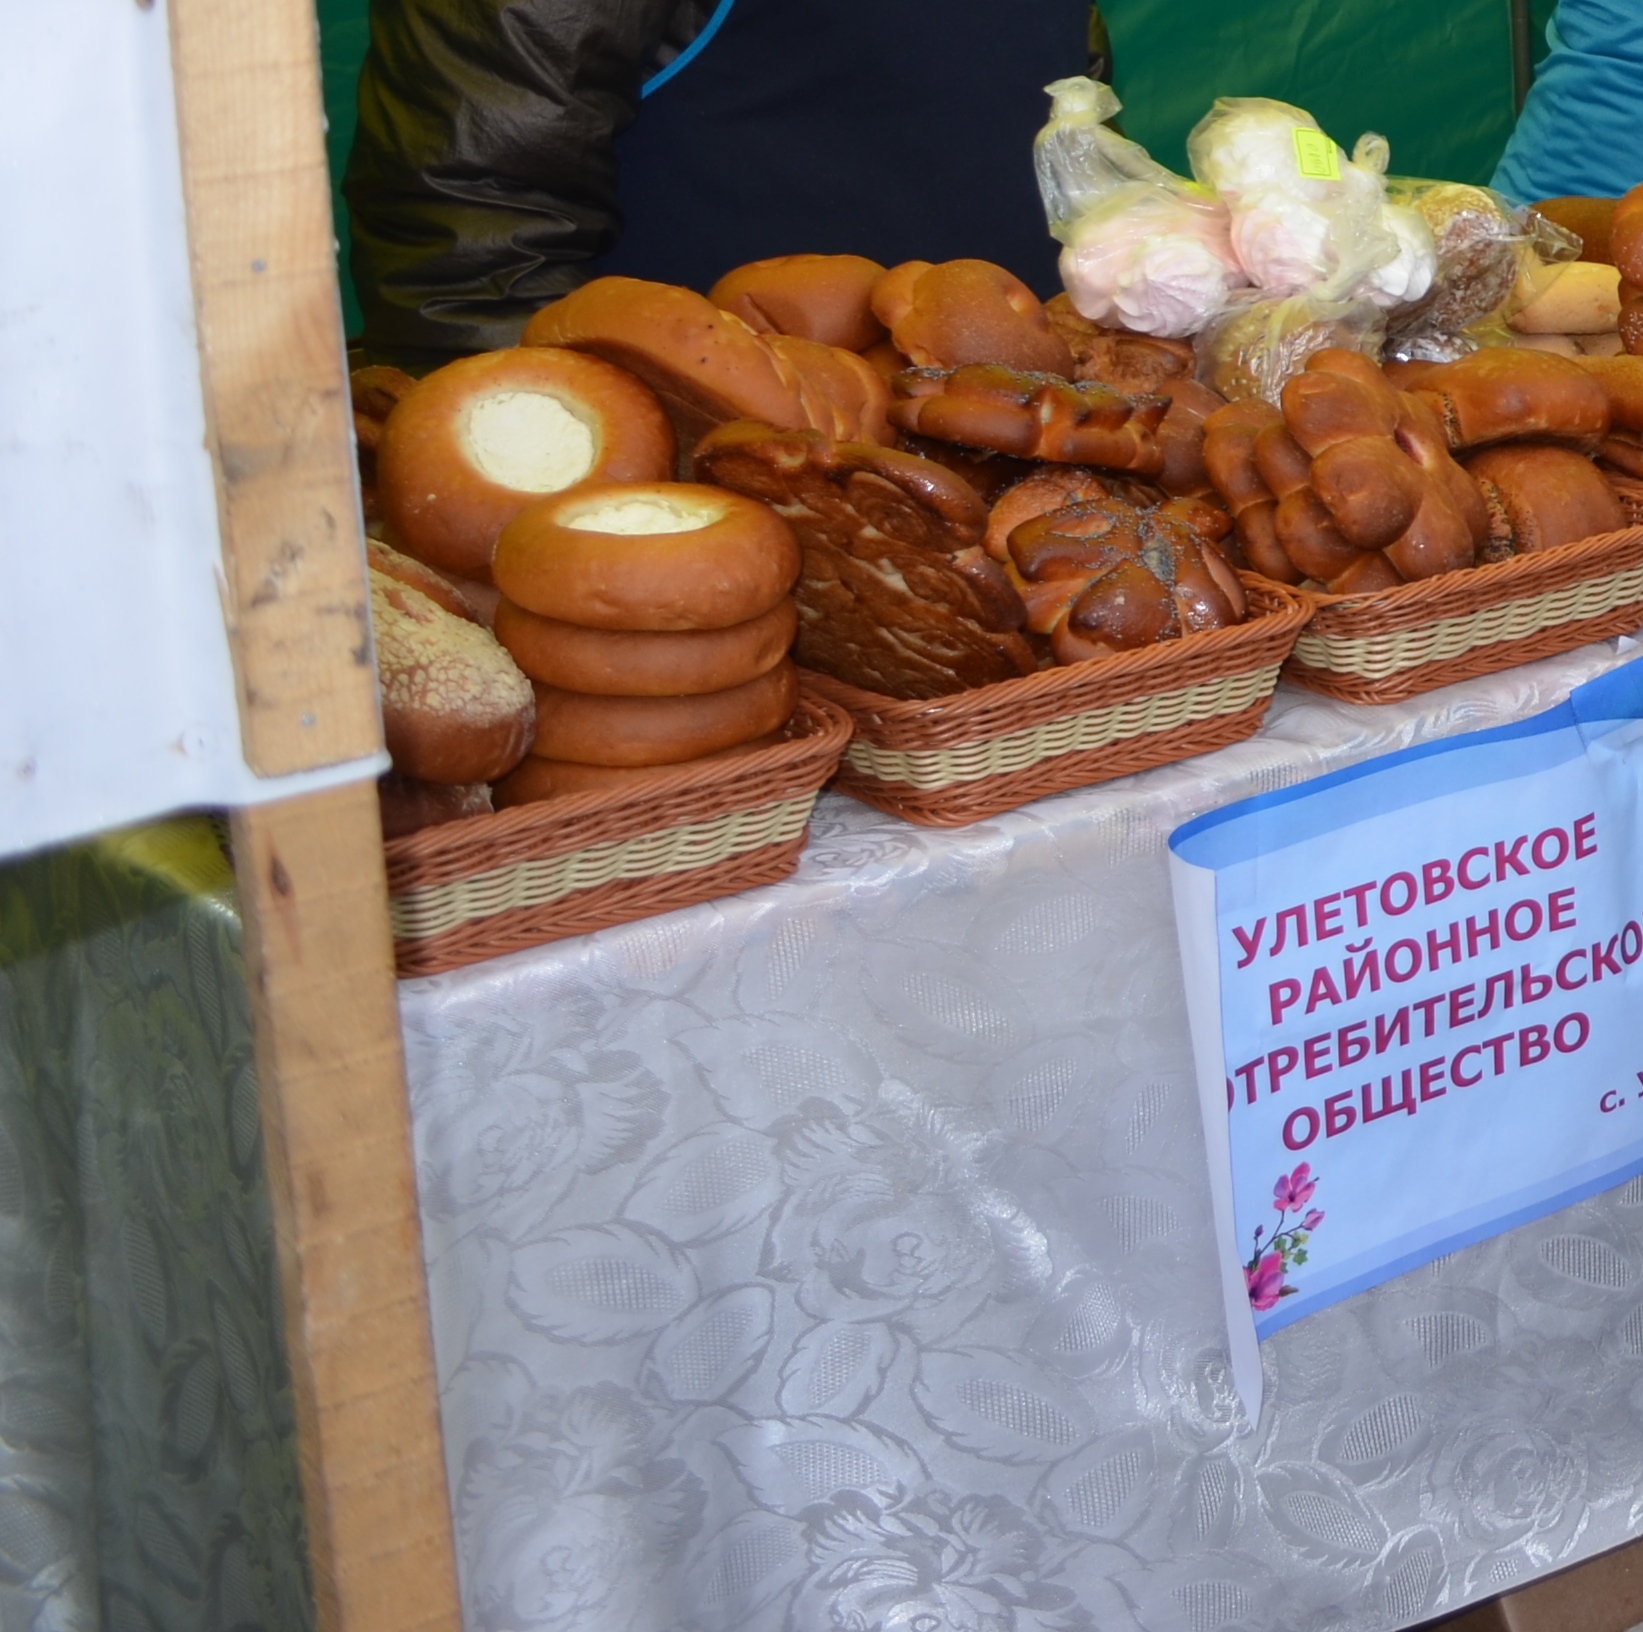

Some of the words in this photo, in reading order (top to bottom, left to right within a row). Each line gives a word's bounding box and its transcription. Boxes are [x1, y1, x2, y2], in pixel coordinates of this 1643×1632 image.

[1231, 812, 1598, 970] УЛЕТОВСКОЕ
[1267, 887, 1577, 1027] РАЙОННОЕ
[1281, 1011, 1591, 1152] ОБЩЕСТВО
[1599, 1089, 1626, 1114] с.
